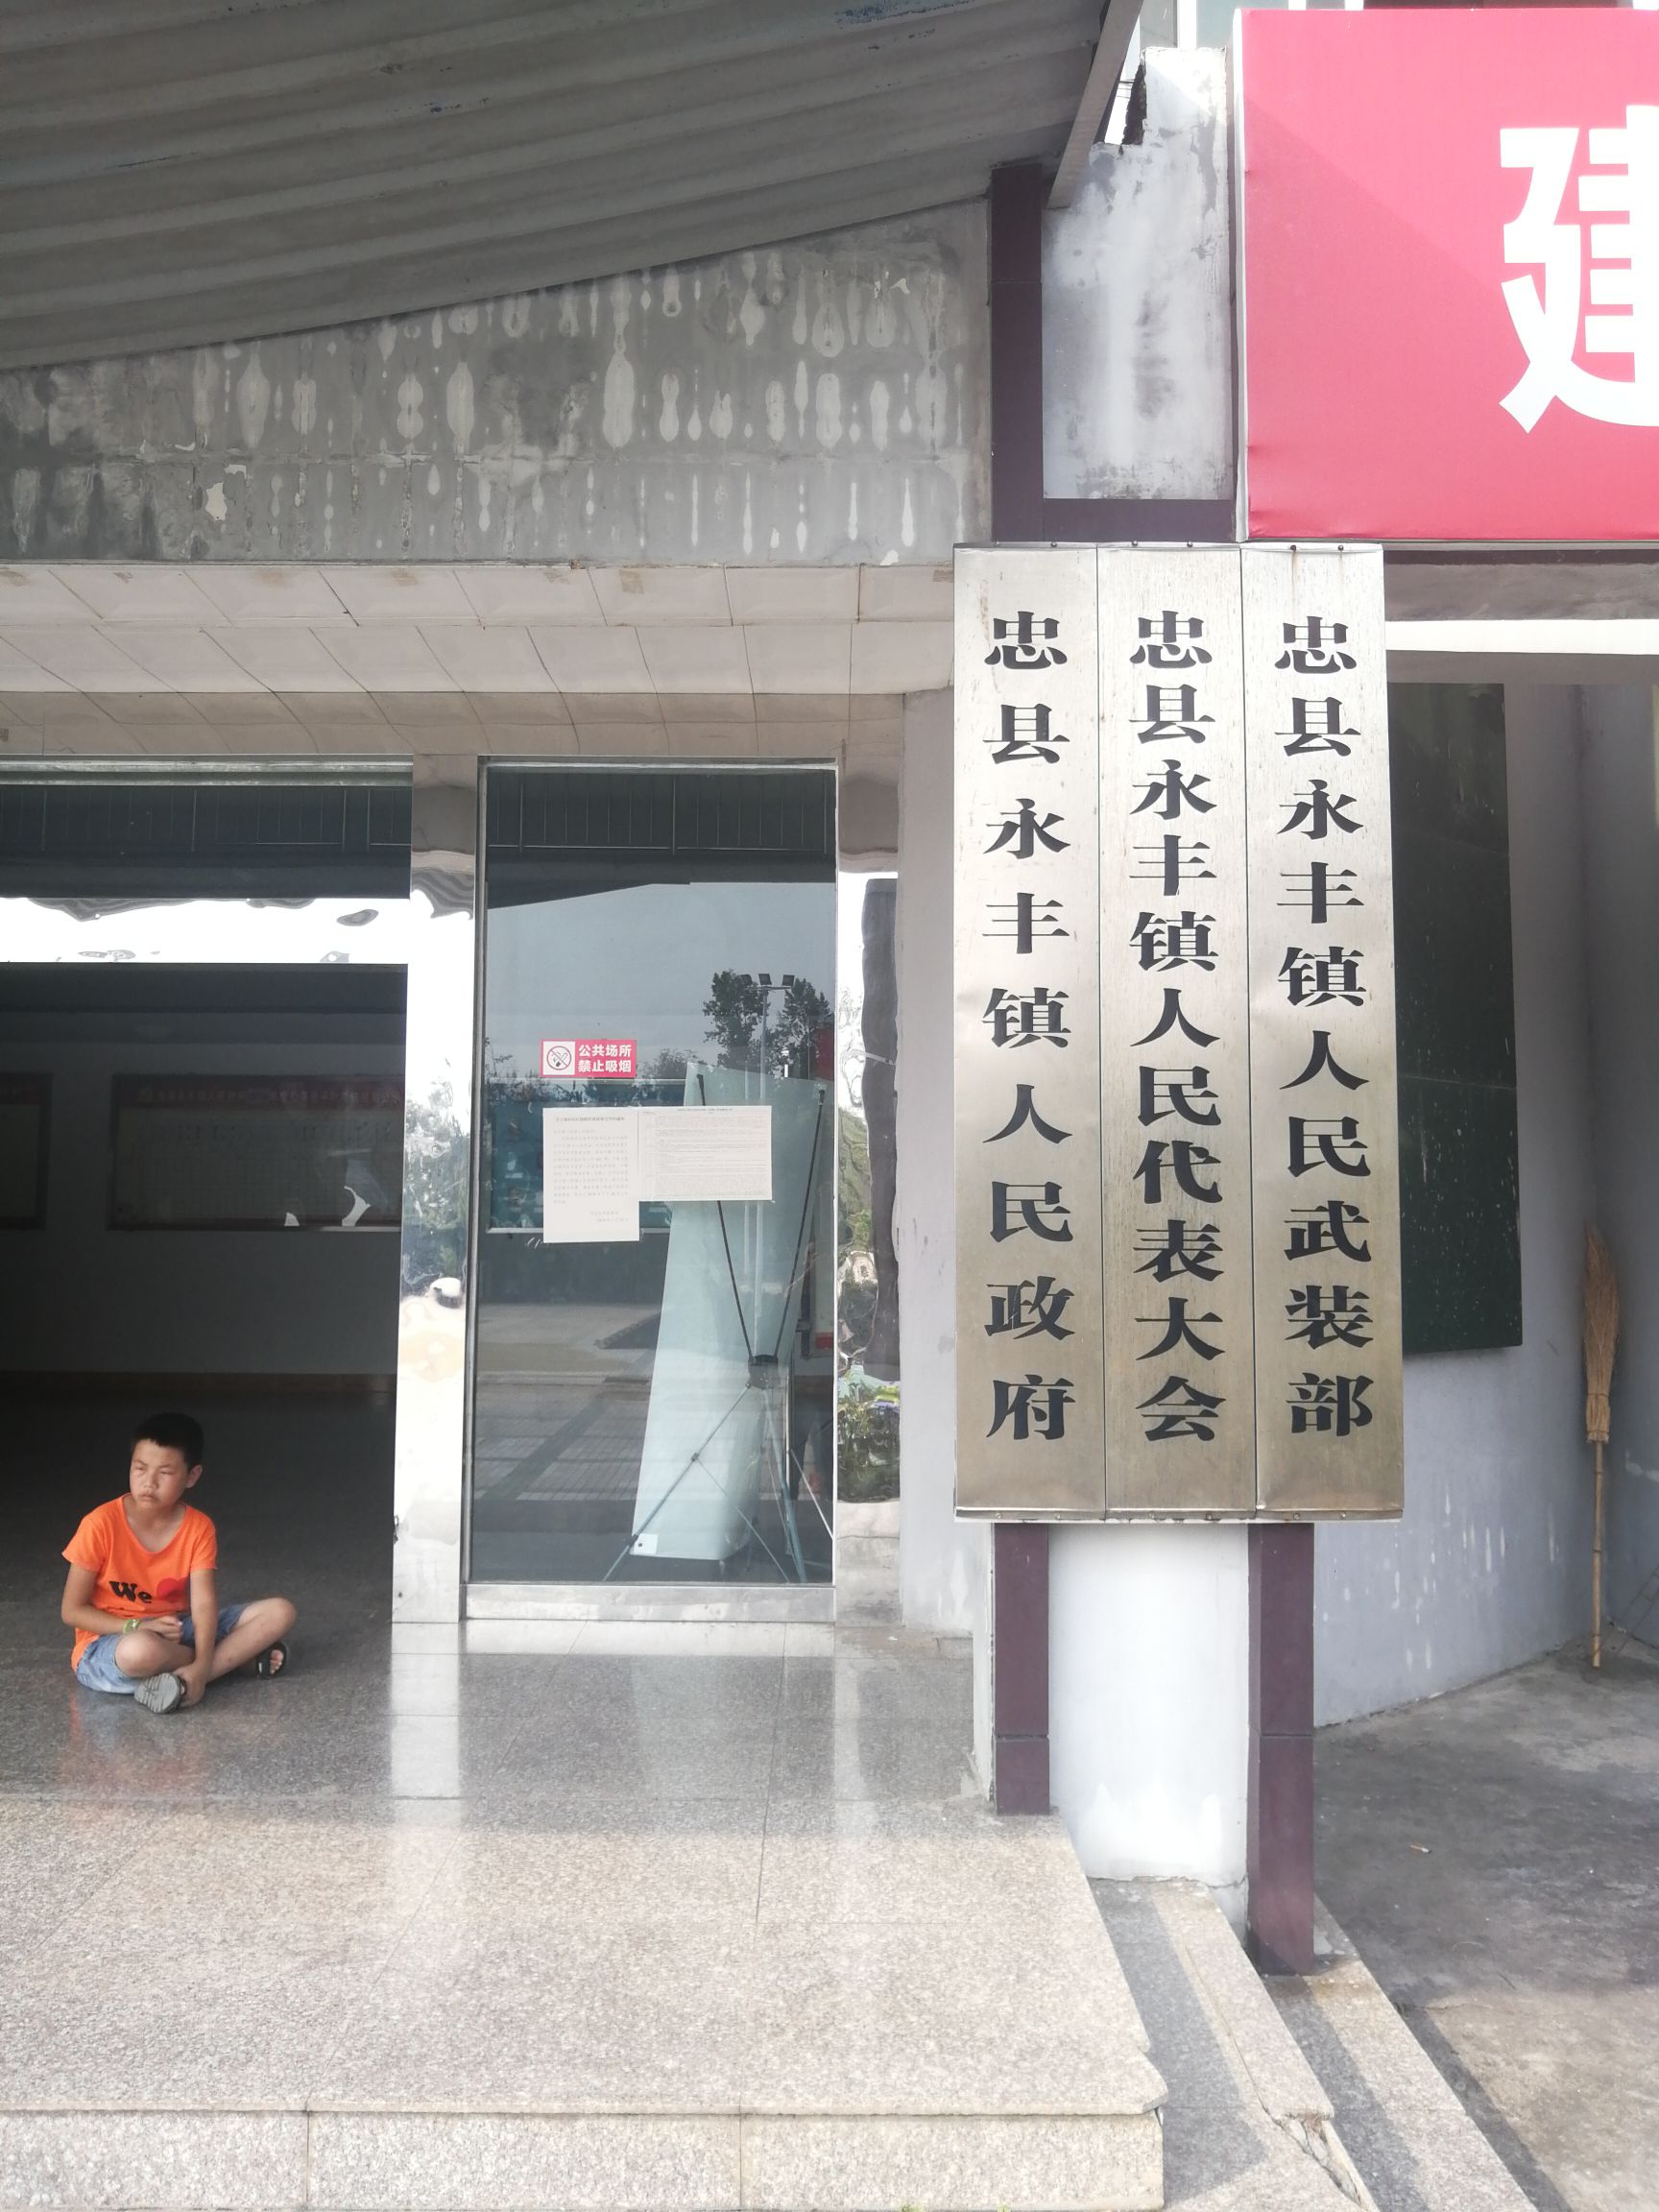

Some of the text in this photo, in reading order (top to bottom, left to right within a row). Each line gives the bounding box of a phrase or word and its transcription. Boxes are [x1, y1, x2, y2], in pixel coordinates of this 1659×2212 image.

[578, 1044, 632, 1057] 公共场所
[578, 1059, 632, 1073] 禁止吸烟
[982, 611, 1075, 1440] 忠县永丰镇人民政府
[1129, 611, 1226, 1441] 忠县永丰镇人民代表大会
[1274, 615, 1376, 1437] 忠县永丰镇人民武装部
[108, 1580, 153, 1604] We
